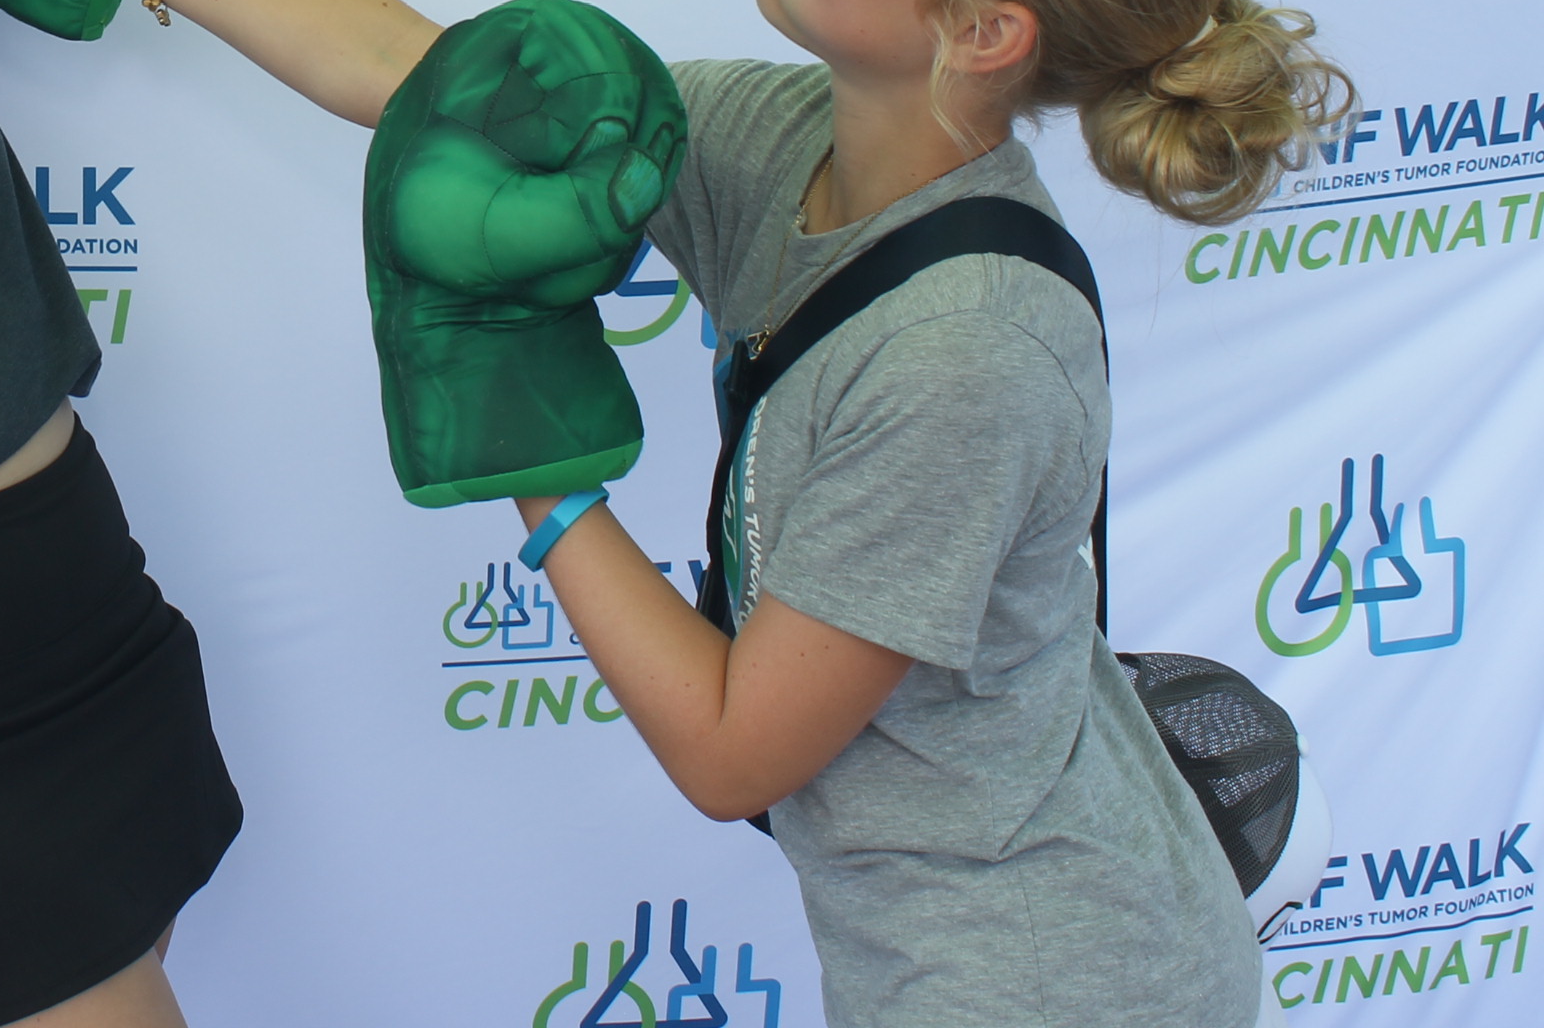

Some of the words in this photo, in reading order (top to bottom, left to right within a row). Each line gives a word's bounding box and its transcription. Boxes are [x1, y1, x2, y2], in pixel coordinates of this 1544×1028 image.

[1395, 162, 1451, 183] TUMOR
[1456, 150, 1544, 173] FOUNDATIO
[35, 167, 136, 225] LK
[56, 238, 138, 255] DATION
[1184, 191, 1544, 285] CINCINNATI
[1310, 856, 1348, 908] F
[1361, 822, 1535, 901] WALK
[1280, 914, 1364, 936] ILDREN'S
[1368, 906, 1428, 925] TUMOR
[1434, 883, 1535, 917] FOUNDATION
[1272, 925, 1529, 1009] CINNATI
